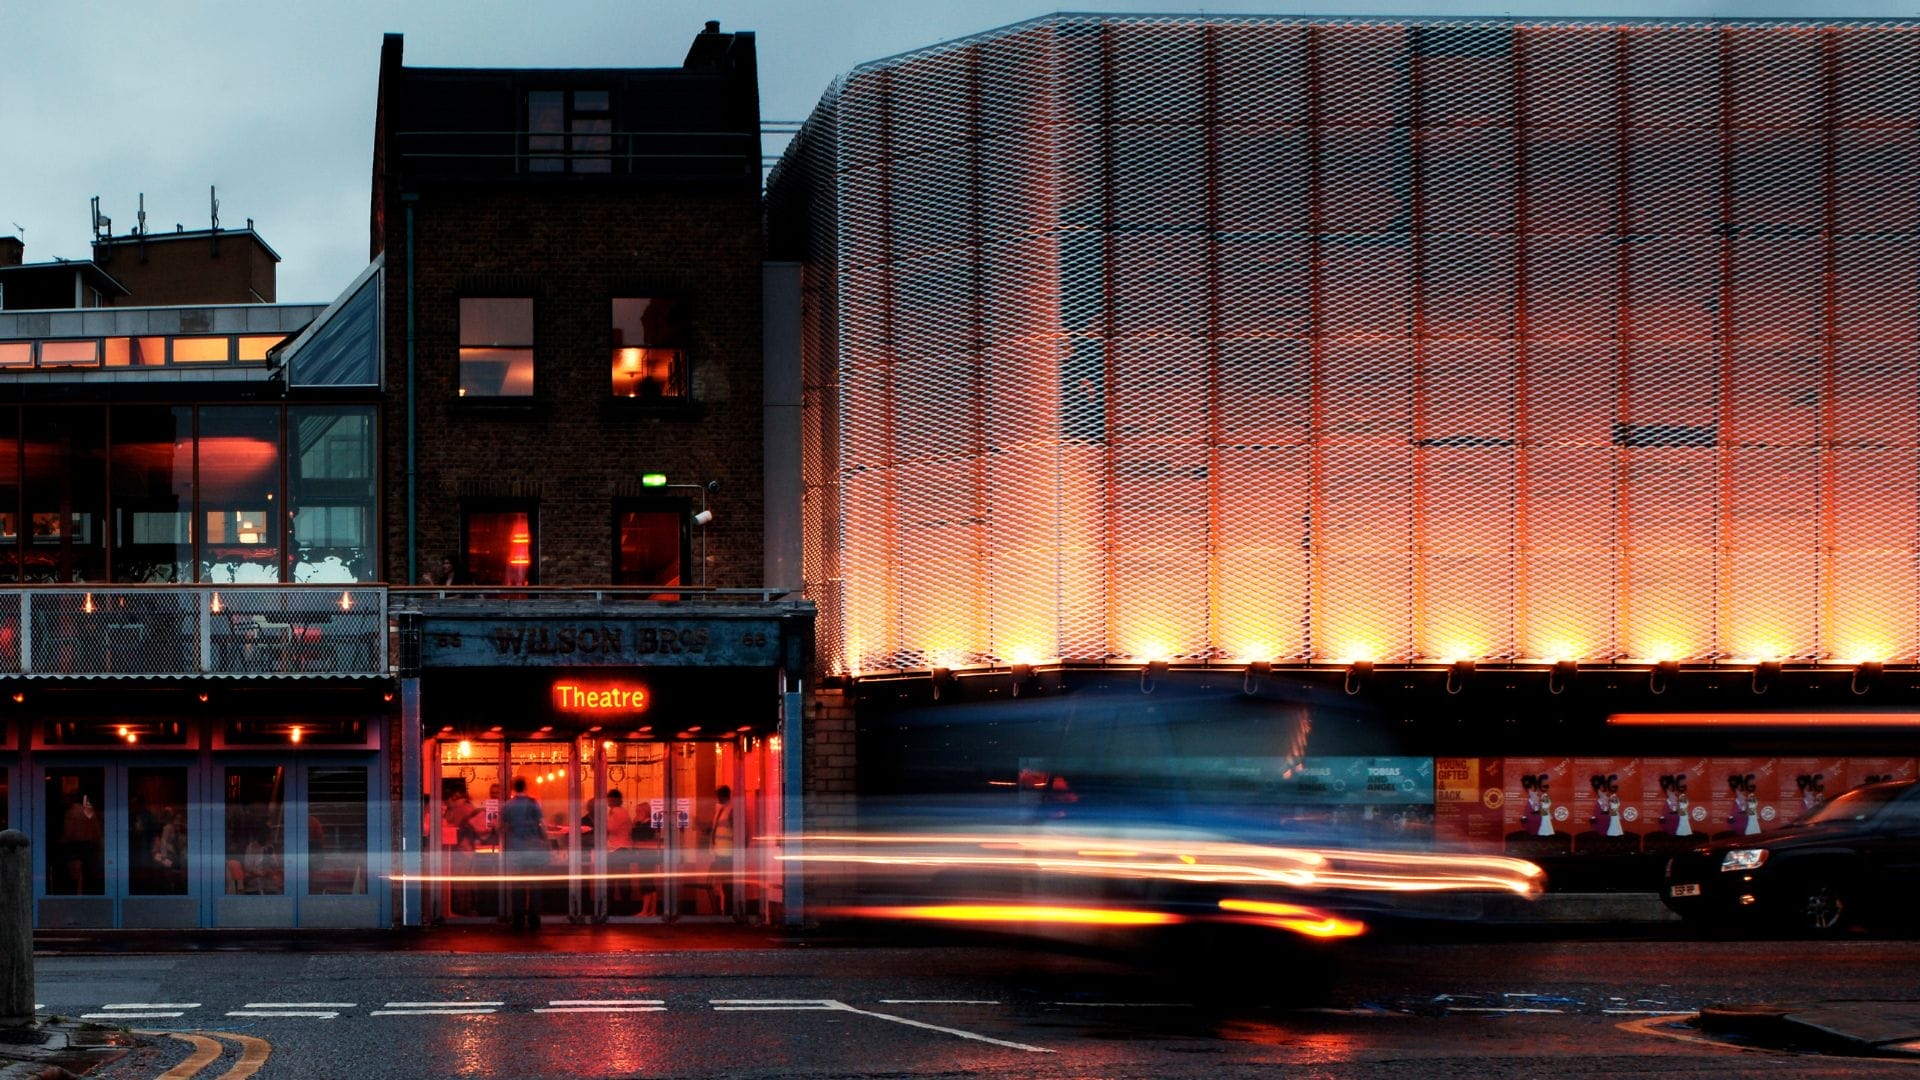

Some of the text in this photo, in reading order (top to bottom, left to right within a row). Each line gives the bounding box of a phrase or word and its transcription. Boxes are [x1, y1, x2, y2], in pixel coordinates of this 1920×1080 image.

[493, 627, 623, 655] WILSON
[556, 685, 644, 708] Theatre
[1438, 759, 1470, 771] YOUNG,
[1367, 767, 1401, 776] TOBIAS
[1438, 770, 1469, 780] GIFTED
[1367, 776, 1388, 784] AND
[1367, 783, 1396, 791] ANGEL
[1438, 781, 1445, 790] &
